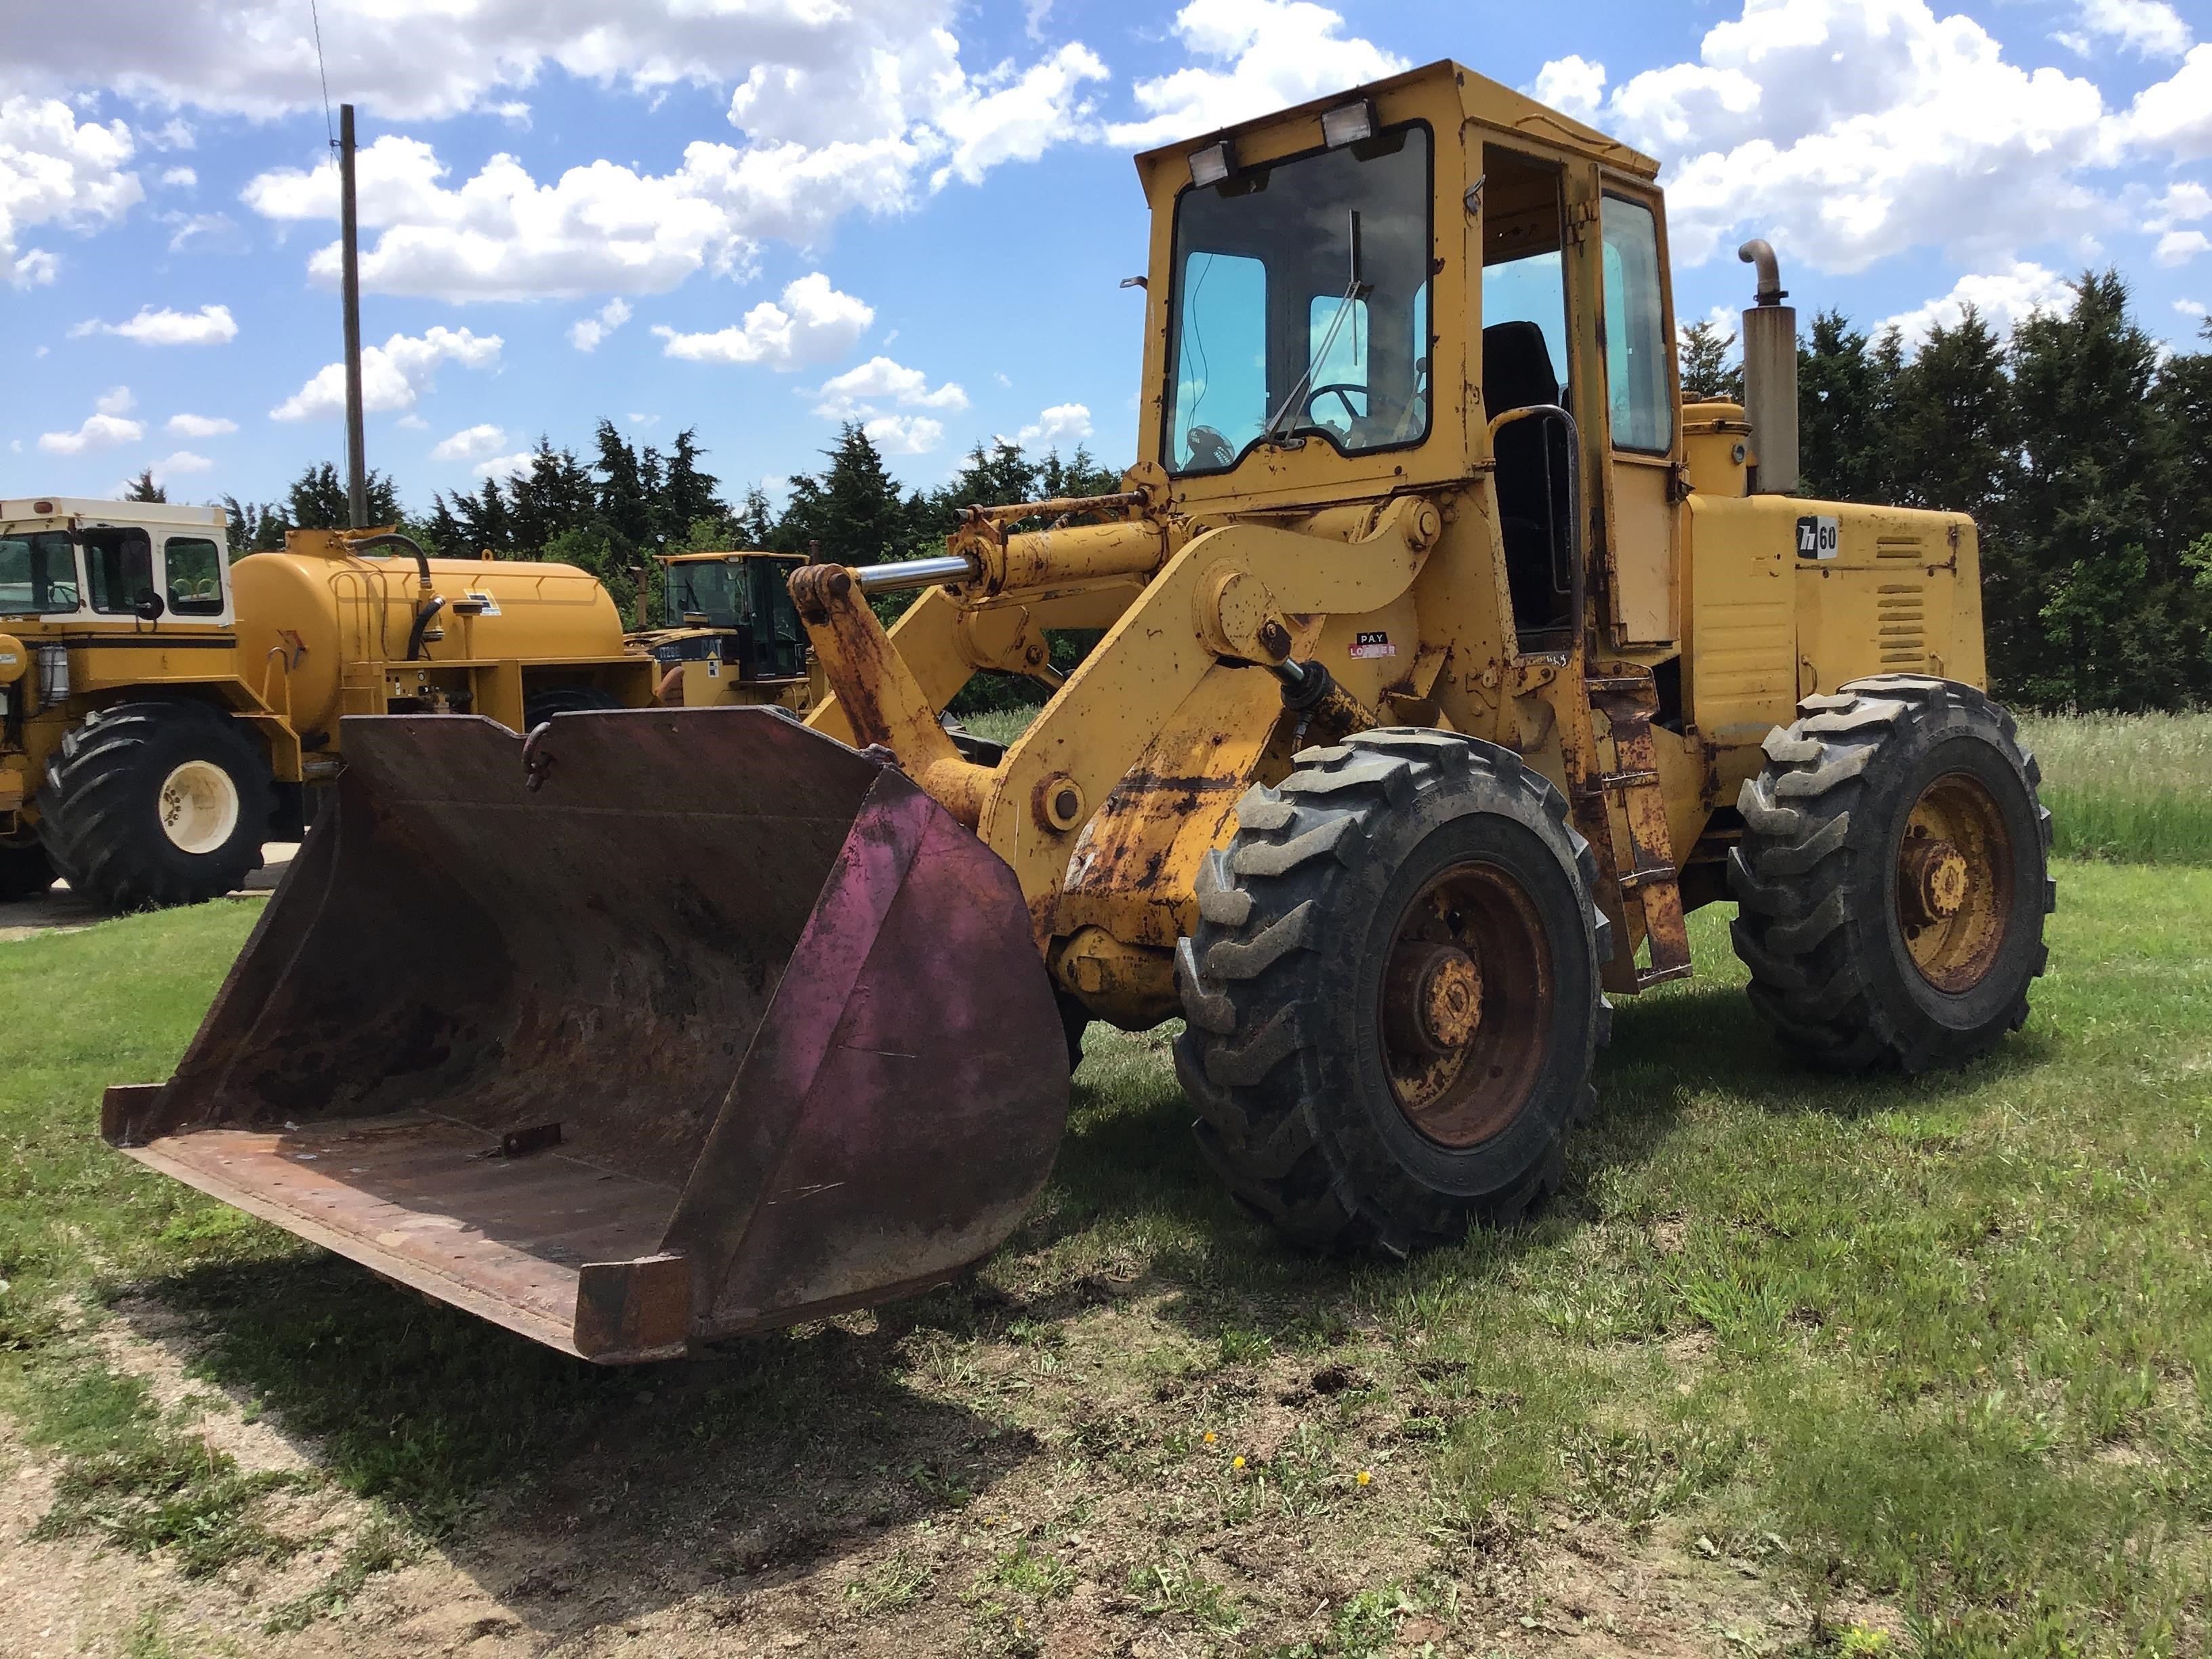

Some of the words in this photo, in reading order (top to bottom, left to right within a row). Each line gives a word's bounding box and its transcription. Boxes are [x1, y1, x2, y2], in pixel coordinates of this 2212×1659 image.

[1820, 527, 1836, 550] 60
[1361, 634, 1383, 643] PAY
[1350, 645, 1395, 656] LOER
